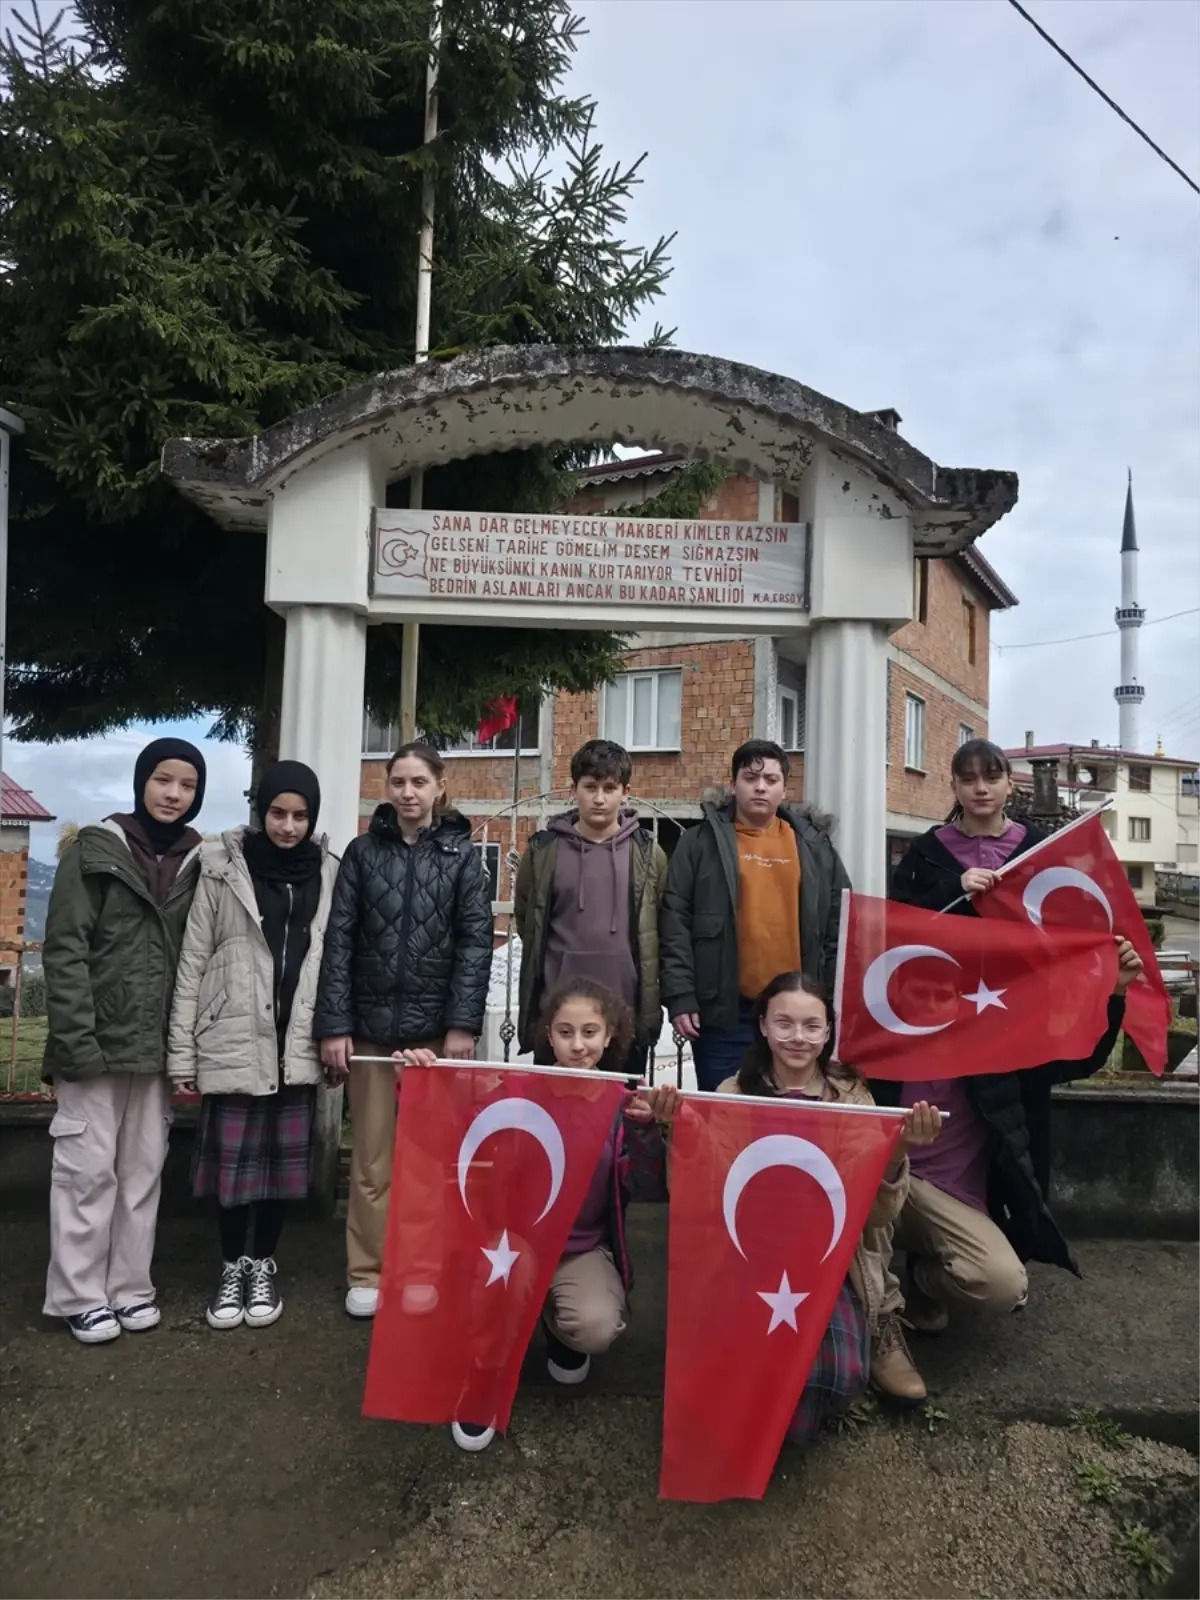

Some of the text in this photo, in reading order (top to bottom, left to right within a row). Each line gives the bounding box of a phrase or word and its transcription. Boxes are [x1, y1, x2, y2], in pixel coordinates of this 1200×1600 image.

[432, 515, 788, 543] SANA DAR GELMEYECEK MAKBERİ KİMLER KAZSIN
[431, 534, 760, 562] GELSENİ TARİHE GÖMELİM DESEM SIĞMAZSIN
[430, 557, 448, 573] NE
[540, 562, 582, 577] KANIN
[588, 563, 673, 581] KURTARIYOR
[682, 563, 743, 583] TEVHİDİ
[429, 576, 477, 595] BEDRİN
[482, 580, 560, 598] ASLANLARI
[566, 583, 613, 599] ANCAK
[619, 584, 636, 600] BU
[639, 586, 686, 602] KADAR
